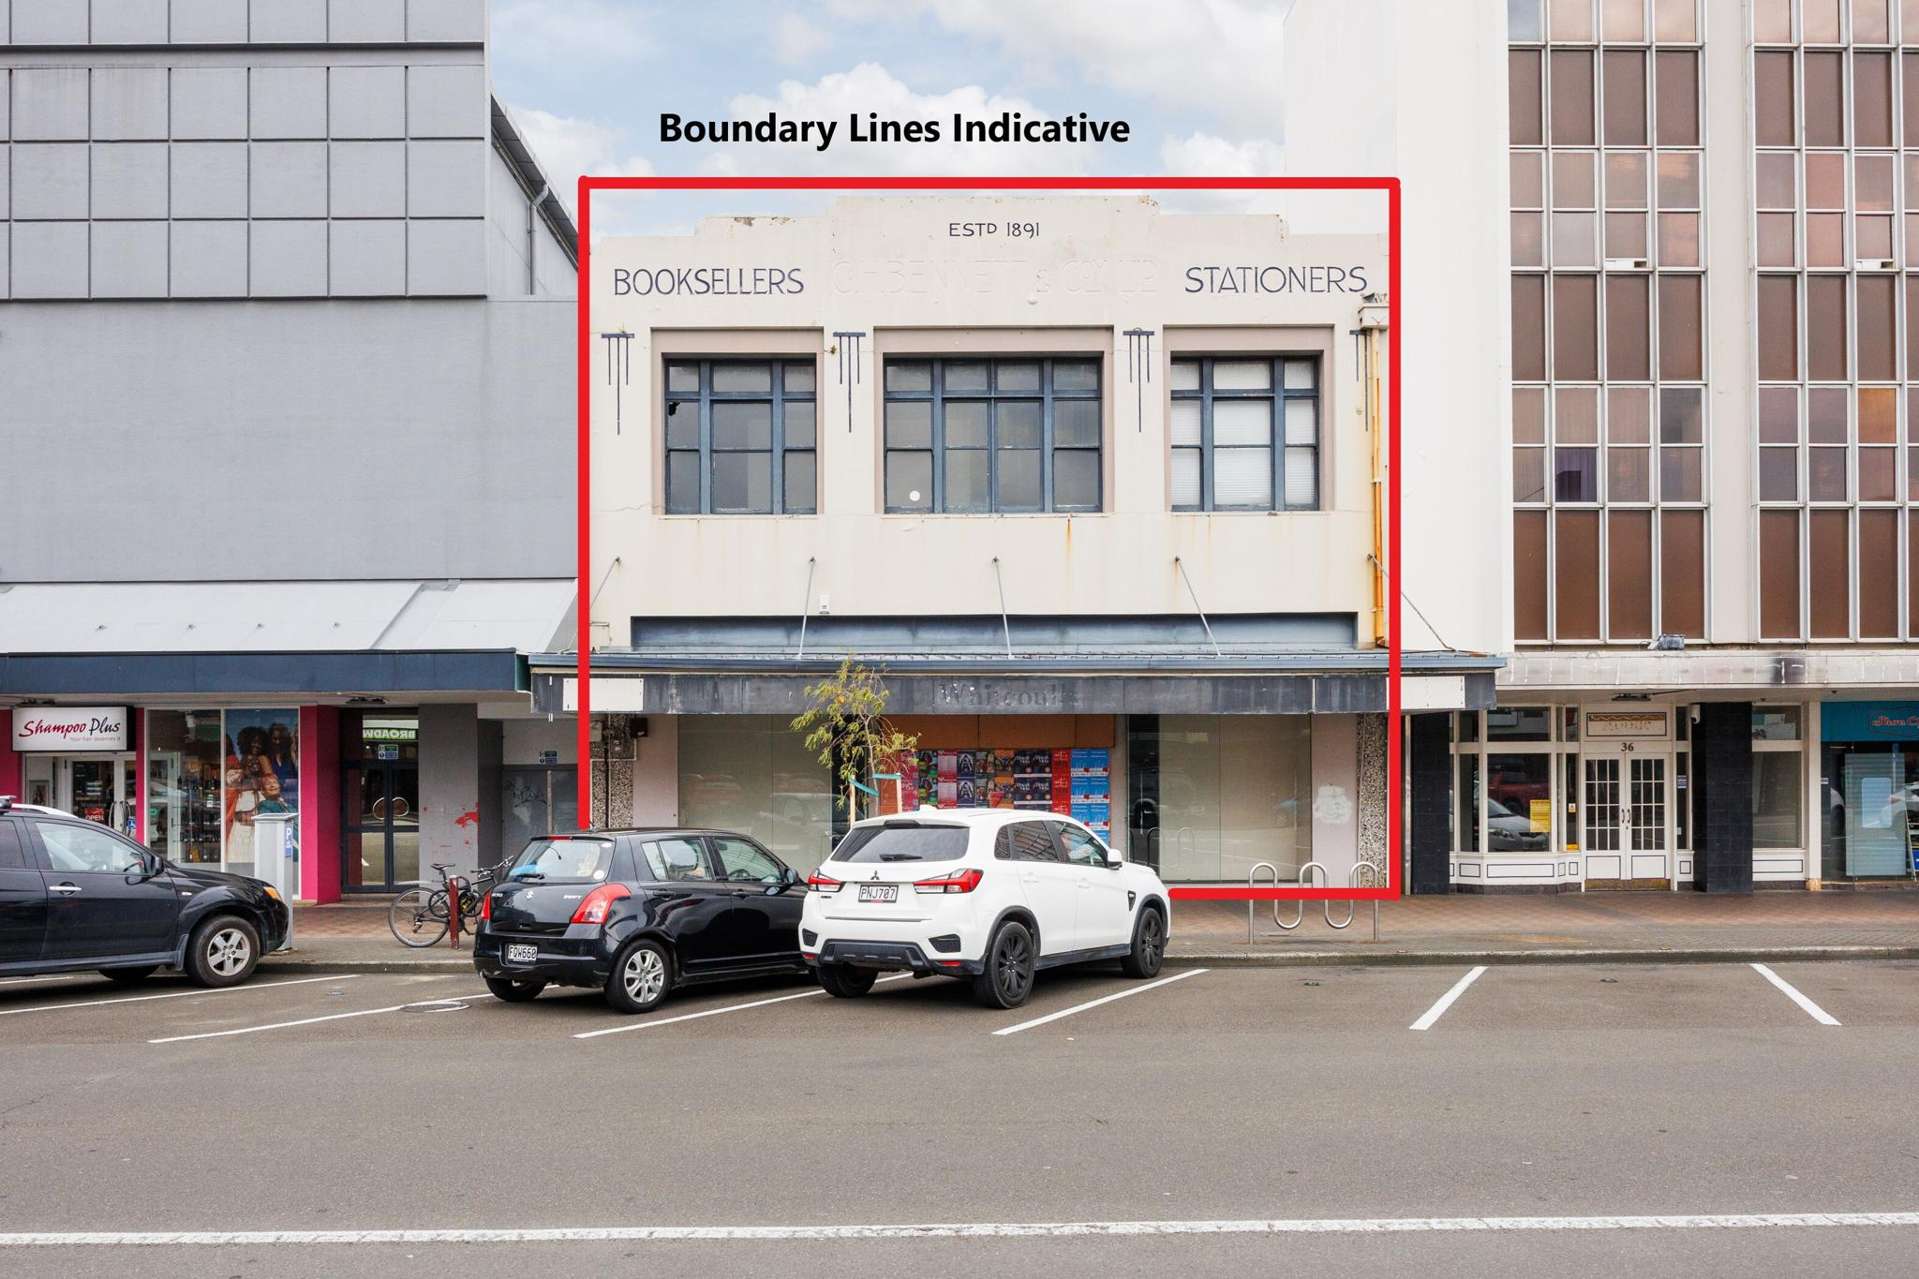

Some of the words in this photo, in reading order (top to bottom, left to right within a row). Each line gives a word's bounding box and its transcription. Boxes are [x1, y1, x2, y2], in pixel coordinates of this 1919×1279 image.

[949, 222, 998, 238] ESTD
[1006, 221, 1040, 240] 1891
[614, 267, 805, 296] BOOKSELLERS
[1184, 265, 1368, 297] STATIONERS
[18, 719, 87, 739] Shampoo
[88, 716, 121, 736] Plus
[1620, 742, 1635, 752] 36
